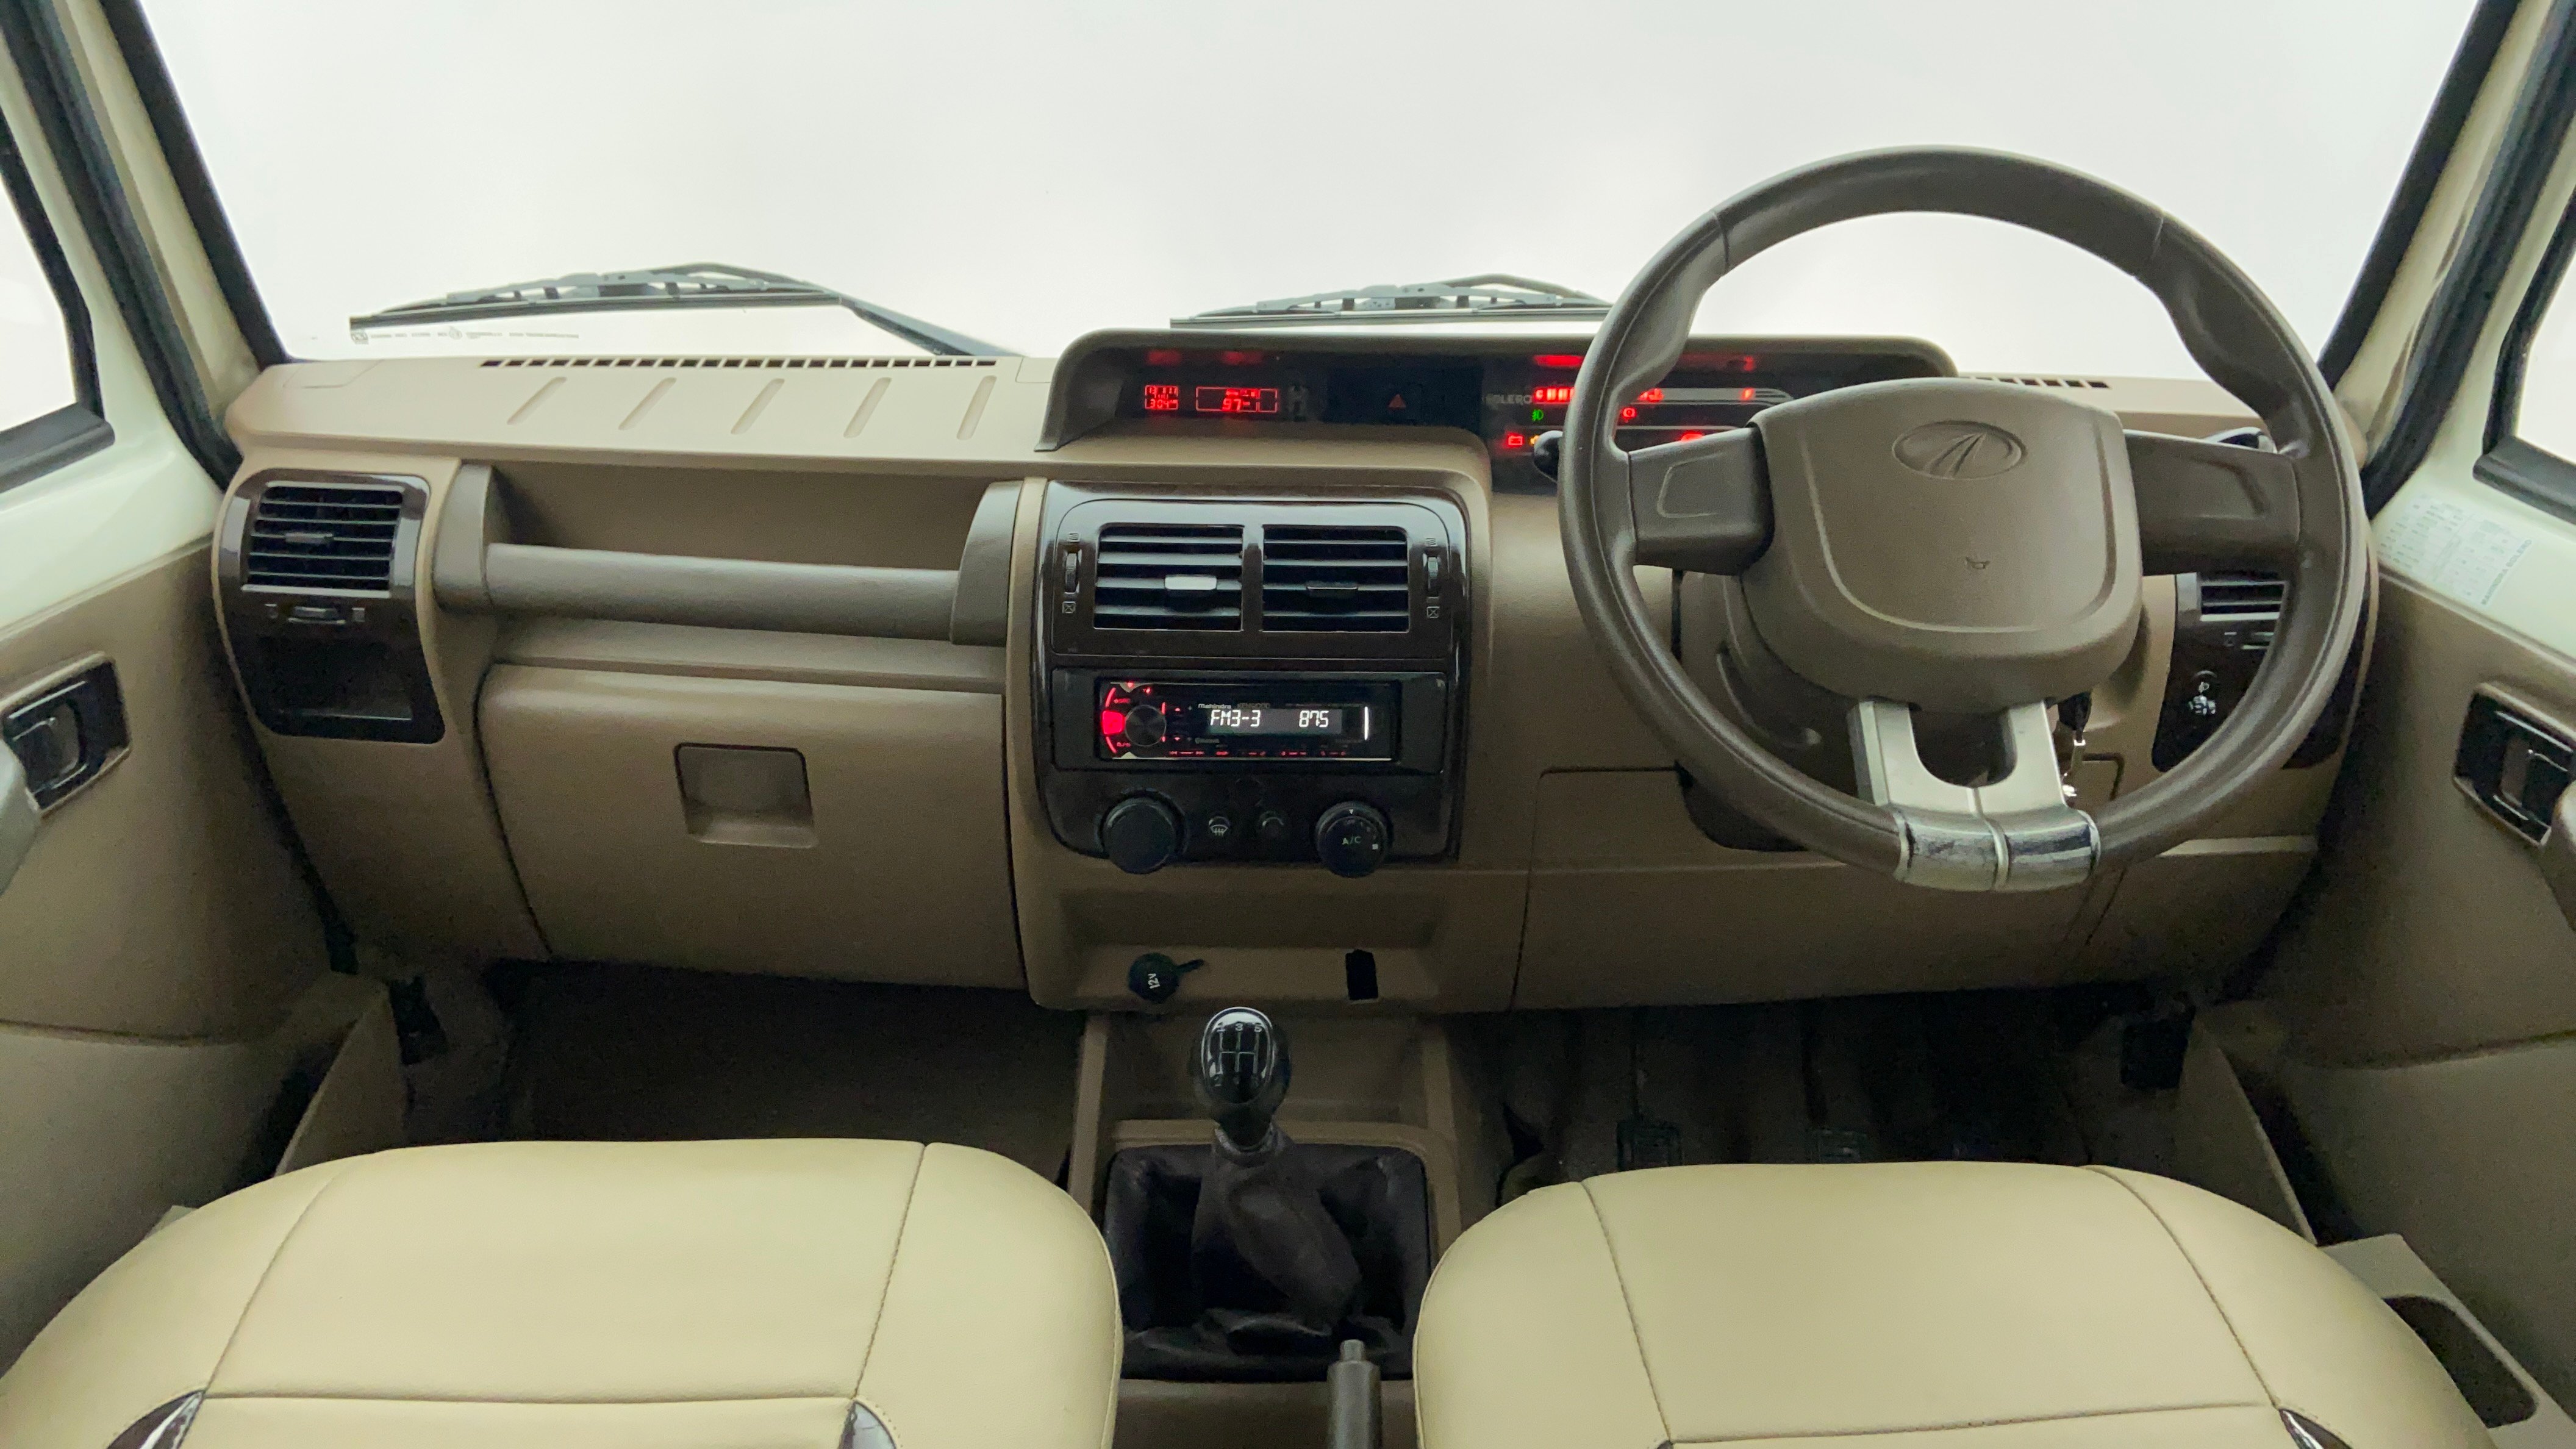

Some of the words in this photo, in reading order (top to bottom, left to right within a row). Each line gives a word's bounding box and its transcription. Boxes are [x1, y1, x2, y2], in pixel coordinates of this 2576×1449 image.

[1210, 709, 1261, 727] FM3-3
[1342, 835, 1362, 845] A/C
[1235, 1023, 1243, 1031] 3
[1254, 1023, 1262, 1032] 5
